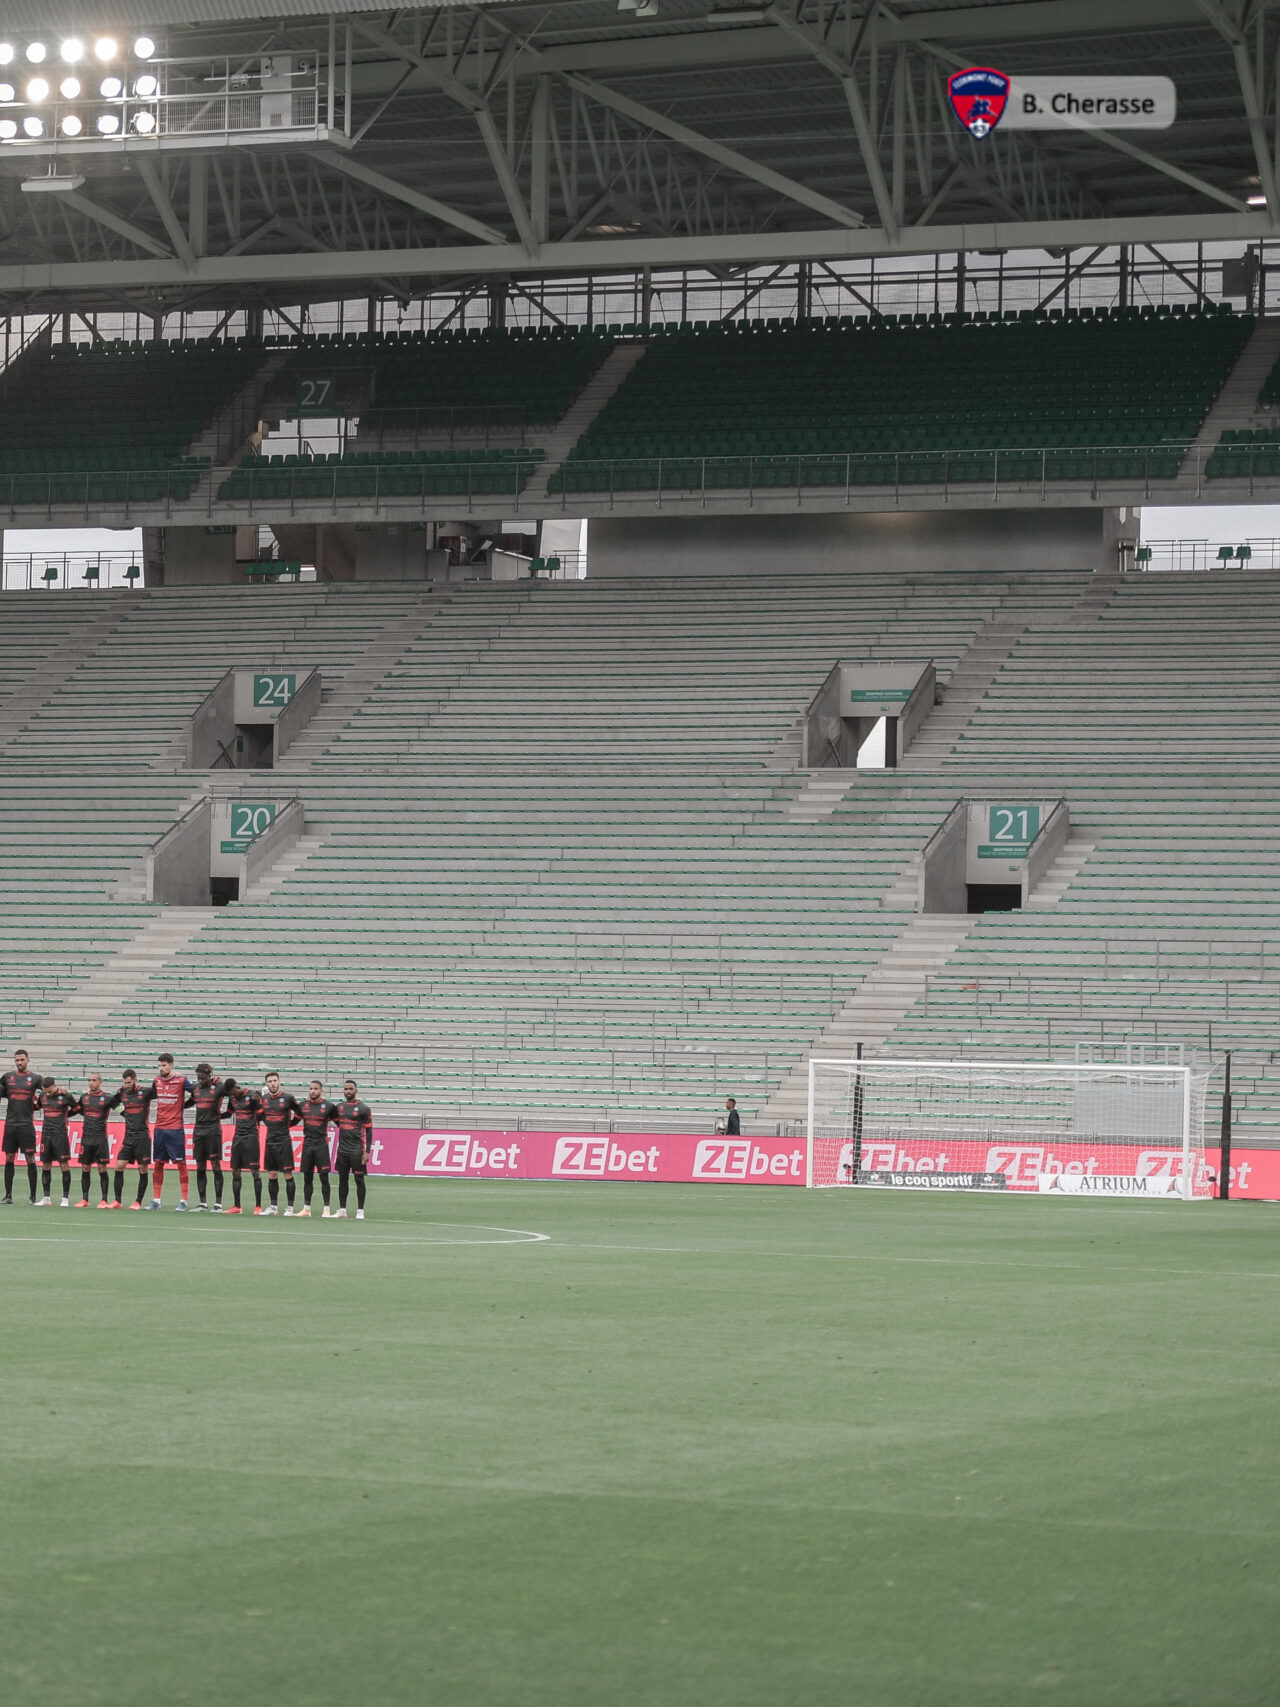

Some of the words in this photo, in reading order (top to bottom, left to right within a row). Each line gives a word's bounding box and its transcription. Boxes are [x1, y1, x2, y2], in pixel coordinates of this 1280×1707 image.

[301, 380, 331, 406] 27
[258, 677, 291, 705] 24
[236, 807, 270, 836] 20
[994, 809, 1028, 840] 21
[421, 1139, 520, 1171] ZEbet
[558, 1142, 660, 1174] ZEbet
[697, 1144, 803, 1178] ZEbet
[891, 1174, 905, 1185] le
[905, 1176, 930, 1188] coq
[931, 1174, 973, 1187] sportif
[1079, 1176, 1148, 1191] ATRIUM
